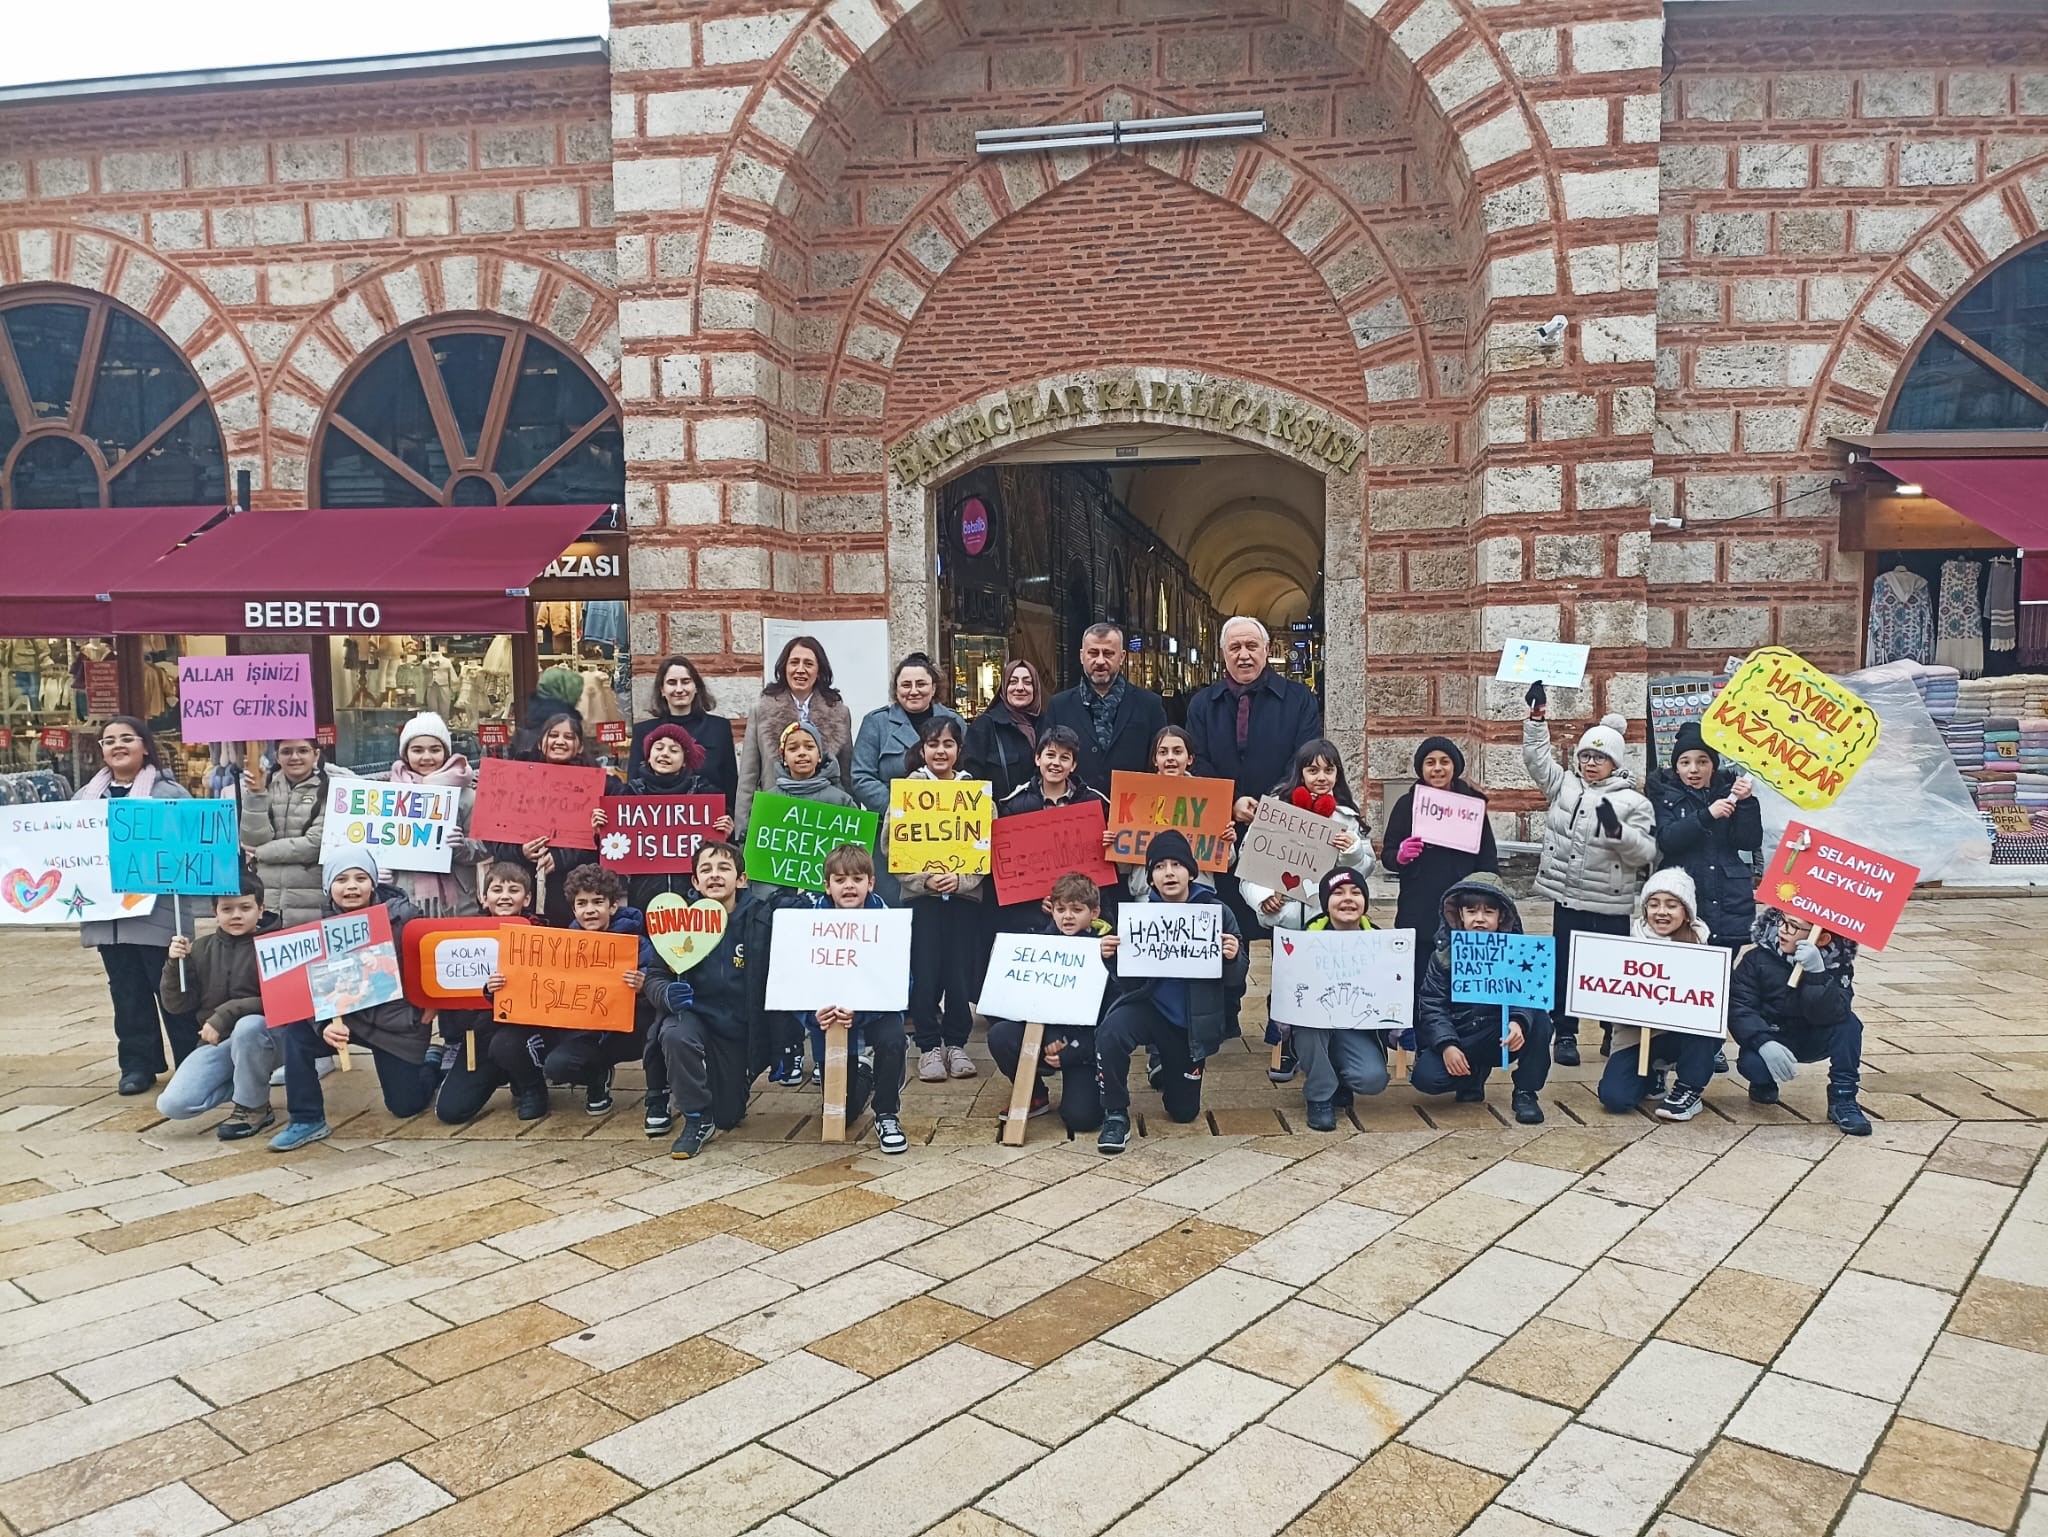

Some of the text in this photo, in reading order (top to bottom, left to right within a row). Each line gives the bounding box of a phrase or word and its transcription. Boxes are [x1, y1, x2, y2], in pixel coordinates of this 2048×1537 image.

[894, 385, 1090, 485] BAKIRCILAR
[1096, 380, 1224, 420] KAPALI
[536, 554, 620, 578] AZASI
[244, 601, 381, 628] BEBETTO
[182, 662, 300, 686] ALLAH İŞİNİZİ
[183, 693, 308, 718] RAST GETİRSİN
[1766, 667, 1853, 734] HAYIRLI
[333, 786, 452, 821] BEREKETLİ
[617, 803, 710, 827] HAYIRLI
[902, 790, 983, 812] KOLAY
[1117, 792, 1209, 828] KLAY
[346, 821, 444, 850] OLSUN!
[783, 806, 861, 836] ALLAH
[894, 815, 982, 842] GELSİN
[637, 830, 703, 861] İŞLER
[771, 857, 824, 886] VERS
[1817, 844, 1896, 884] SELAMÜN
[1806, 865, 1884, 903] ALEYKÜM
[645, 906, 723, 936] GÜNAYDIN
[1791, 896, 1866, 933] GÜNAYDIN
[812, 921, 879, 943] HAYIRLI
[1452, 931, 1508, 948] ALLAH
[259, 920, 370, 974] HAYIRLI İŞLER
[451, 947, 487, 959] KOLAY
[509, 931, 616, 969] HAYIRLI
[1011, 946, 1086, 969] SELAMUN
[1004, 968, 1077, 990] ALEYKUM
[1454, 960, 1494, 976] RAST
[1623, 959, 1671, 981] BOL
[530, 972, 608, 1017] İŞLER
[1578, 974, 1716, 1008] KAZANÇLAR
